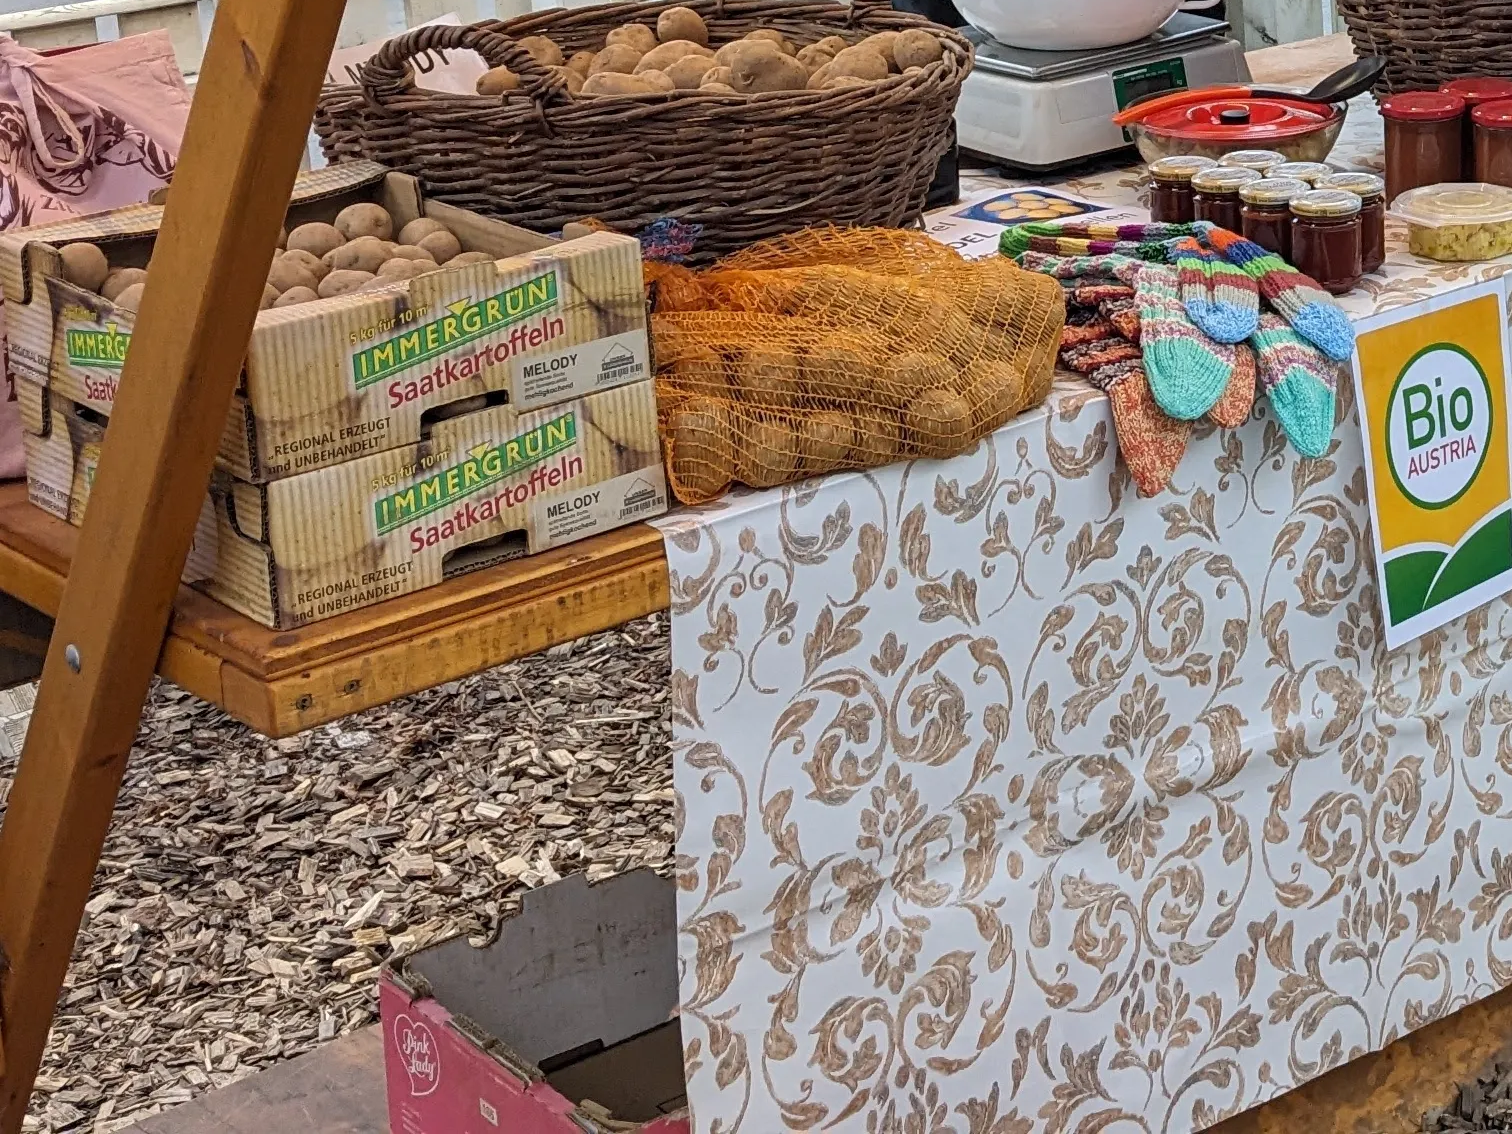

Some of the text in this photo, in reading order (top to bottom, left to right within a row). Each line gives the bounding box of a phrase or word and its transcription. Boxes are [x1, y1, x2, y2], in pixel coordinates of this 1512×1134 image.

[350, 333, 357, 345] 5
[360, 327, 375, 341] kg
[378, 318, 396, 332] für
[399, 309, 413, 324] 10
[388, 316, 565, 409] Saatkartoffeln
[523, 353, 578, 379] MELODY
[1402, 377, 1473, 450] Bio
[340, 417, 391, 440] ERZEUGT
[268, 459, 291, 475] und
[1408, 434, 1477, 479] AUSTRIA
[372, 479, 379, 491] 5
[382, 473, 397, 486] kg
[400, 463, 417, 477] für
[421, 455, 434, 469] 10
[410, 456, 584, 554] Saatkartoffeln
[547, 490, 600, 518] MELODY
[362, 561, 413, 585] ERZEUGT
[293, 607, 314, 623] und
[403, 1029, 429, 1054] Pink
[408, 1051, 436, 1081] Lady
